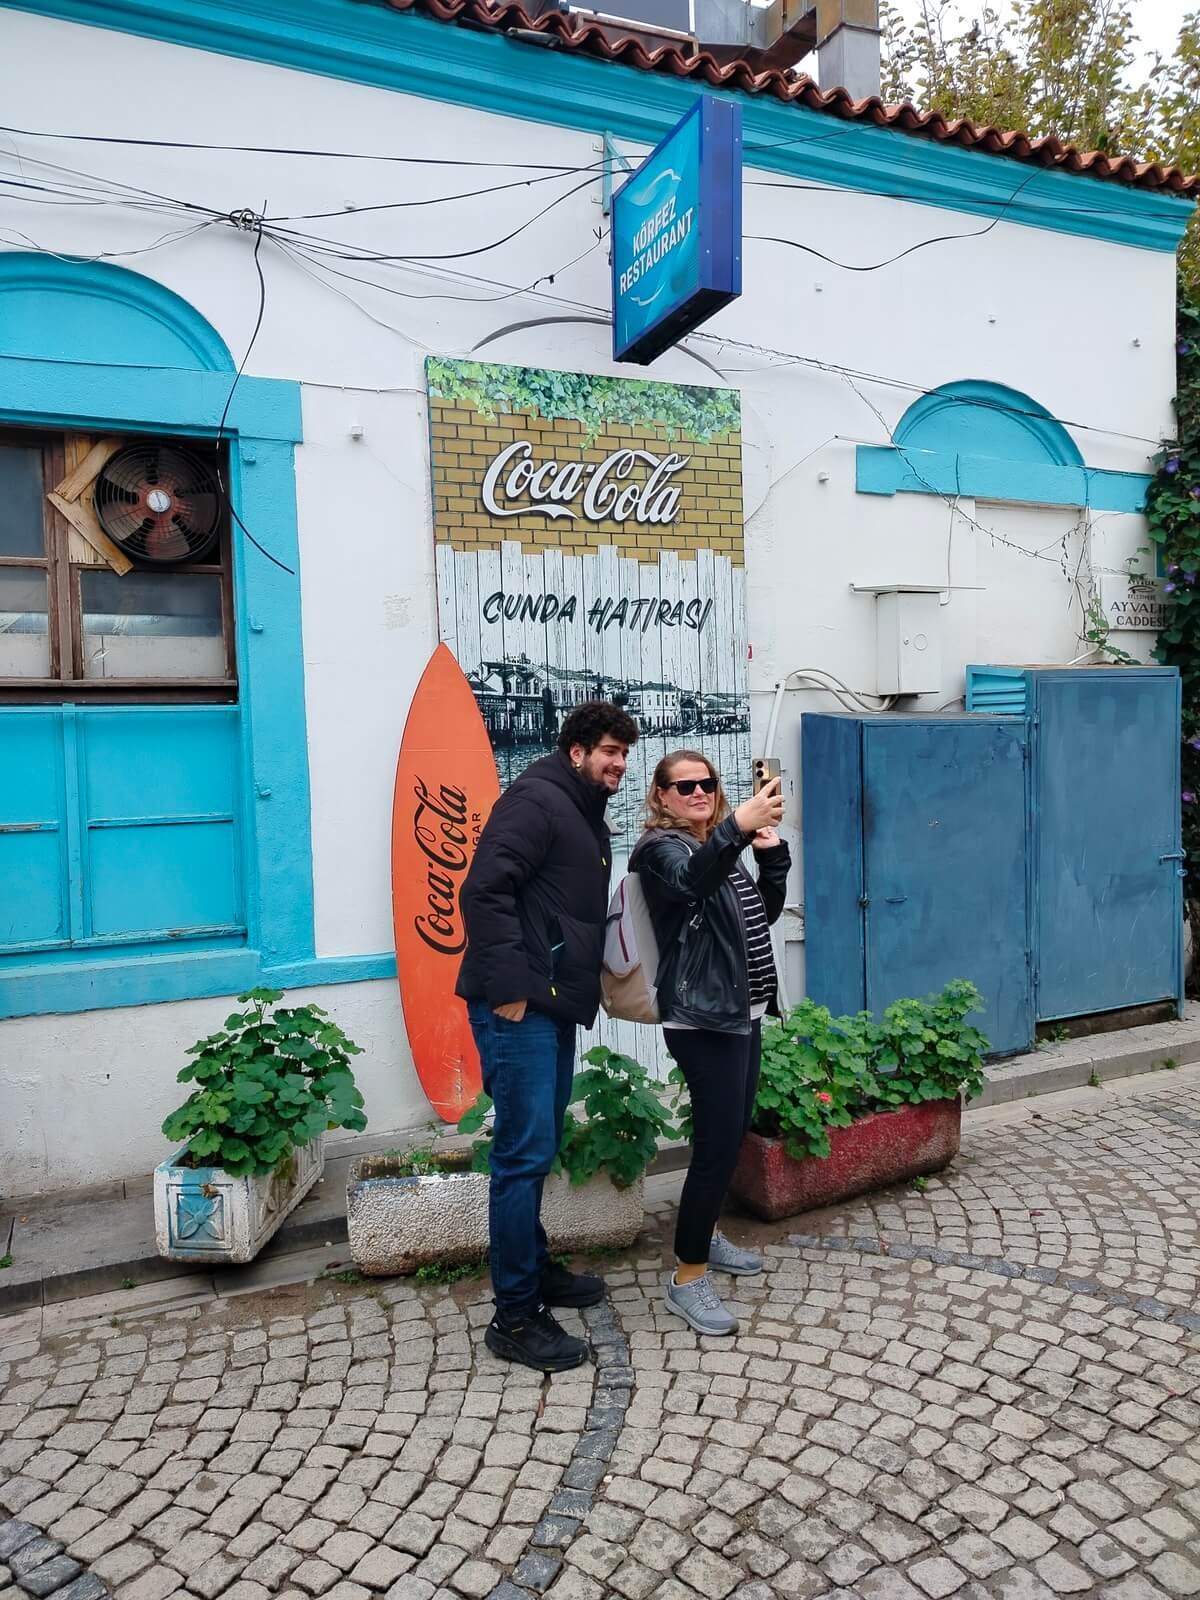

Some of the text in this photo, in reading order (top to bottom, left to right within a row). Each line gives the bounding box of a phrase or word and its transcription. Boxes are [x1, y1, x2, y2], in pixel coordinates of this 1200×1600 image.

[620, 207, 694, 297] RESTAURANT
[633, 194, 677, 257] KÖRFEZ
[482, 440, 693, 524] Coca-Cola
[482, 591, 714, 634] CUNDA HATIRASI
[413, 774, 469, 956] Coca-Cola
[471, 812, 481, 853] GAR
